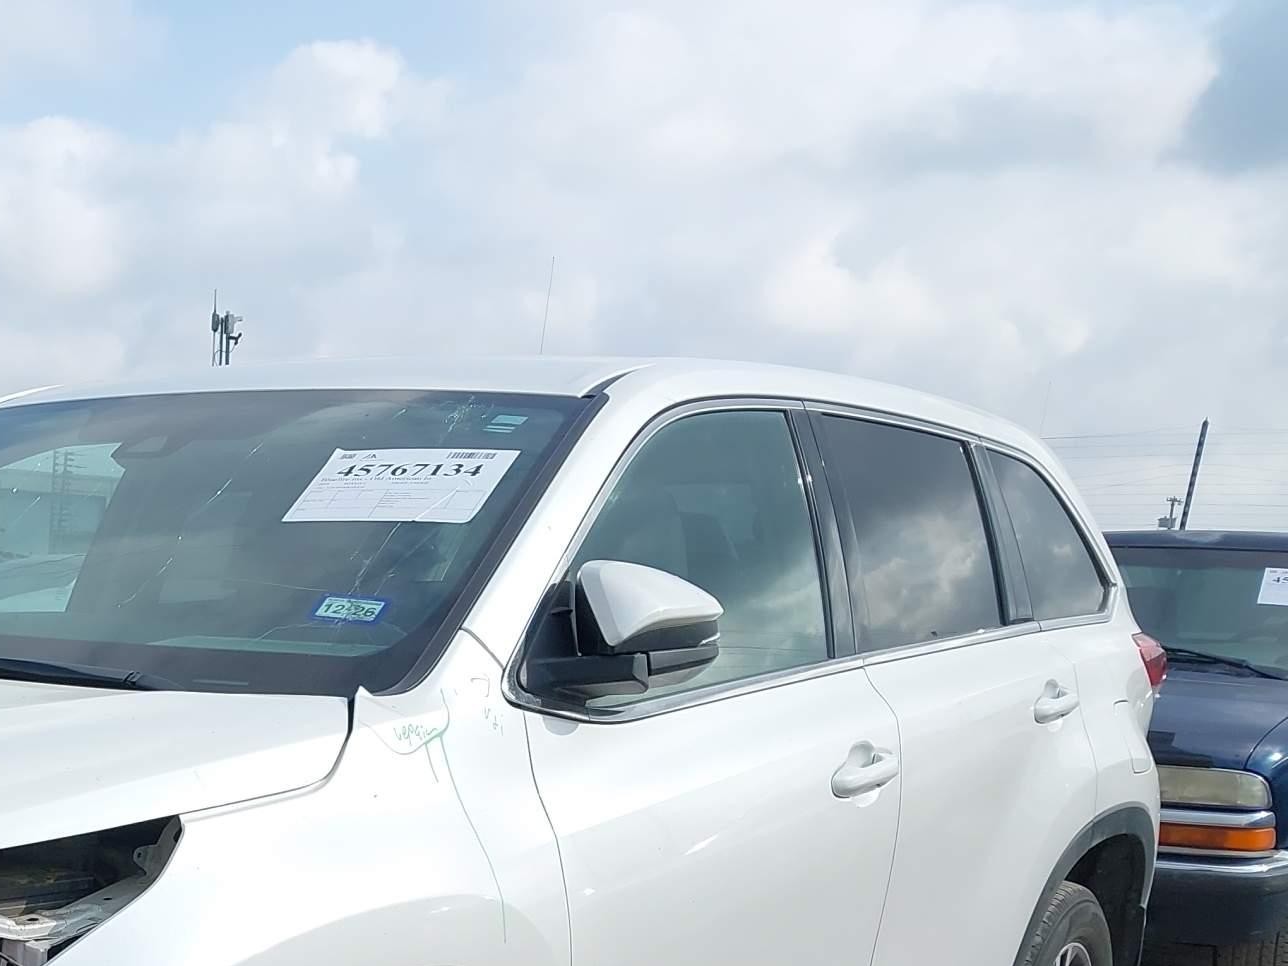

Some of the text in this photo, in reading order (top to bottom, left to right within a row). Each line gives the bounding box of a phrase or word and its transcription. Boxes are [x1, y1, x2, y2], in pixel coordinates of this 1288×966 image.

[336, 463, 484, 477] 45767134
[322, 603, 376, 617] 12 26
